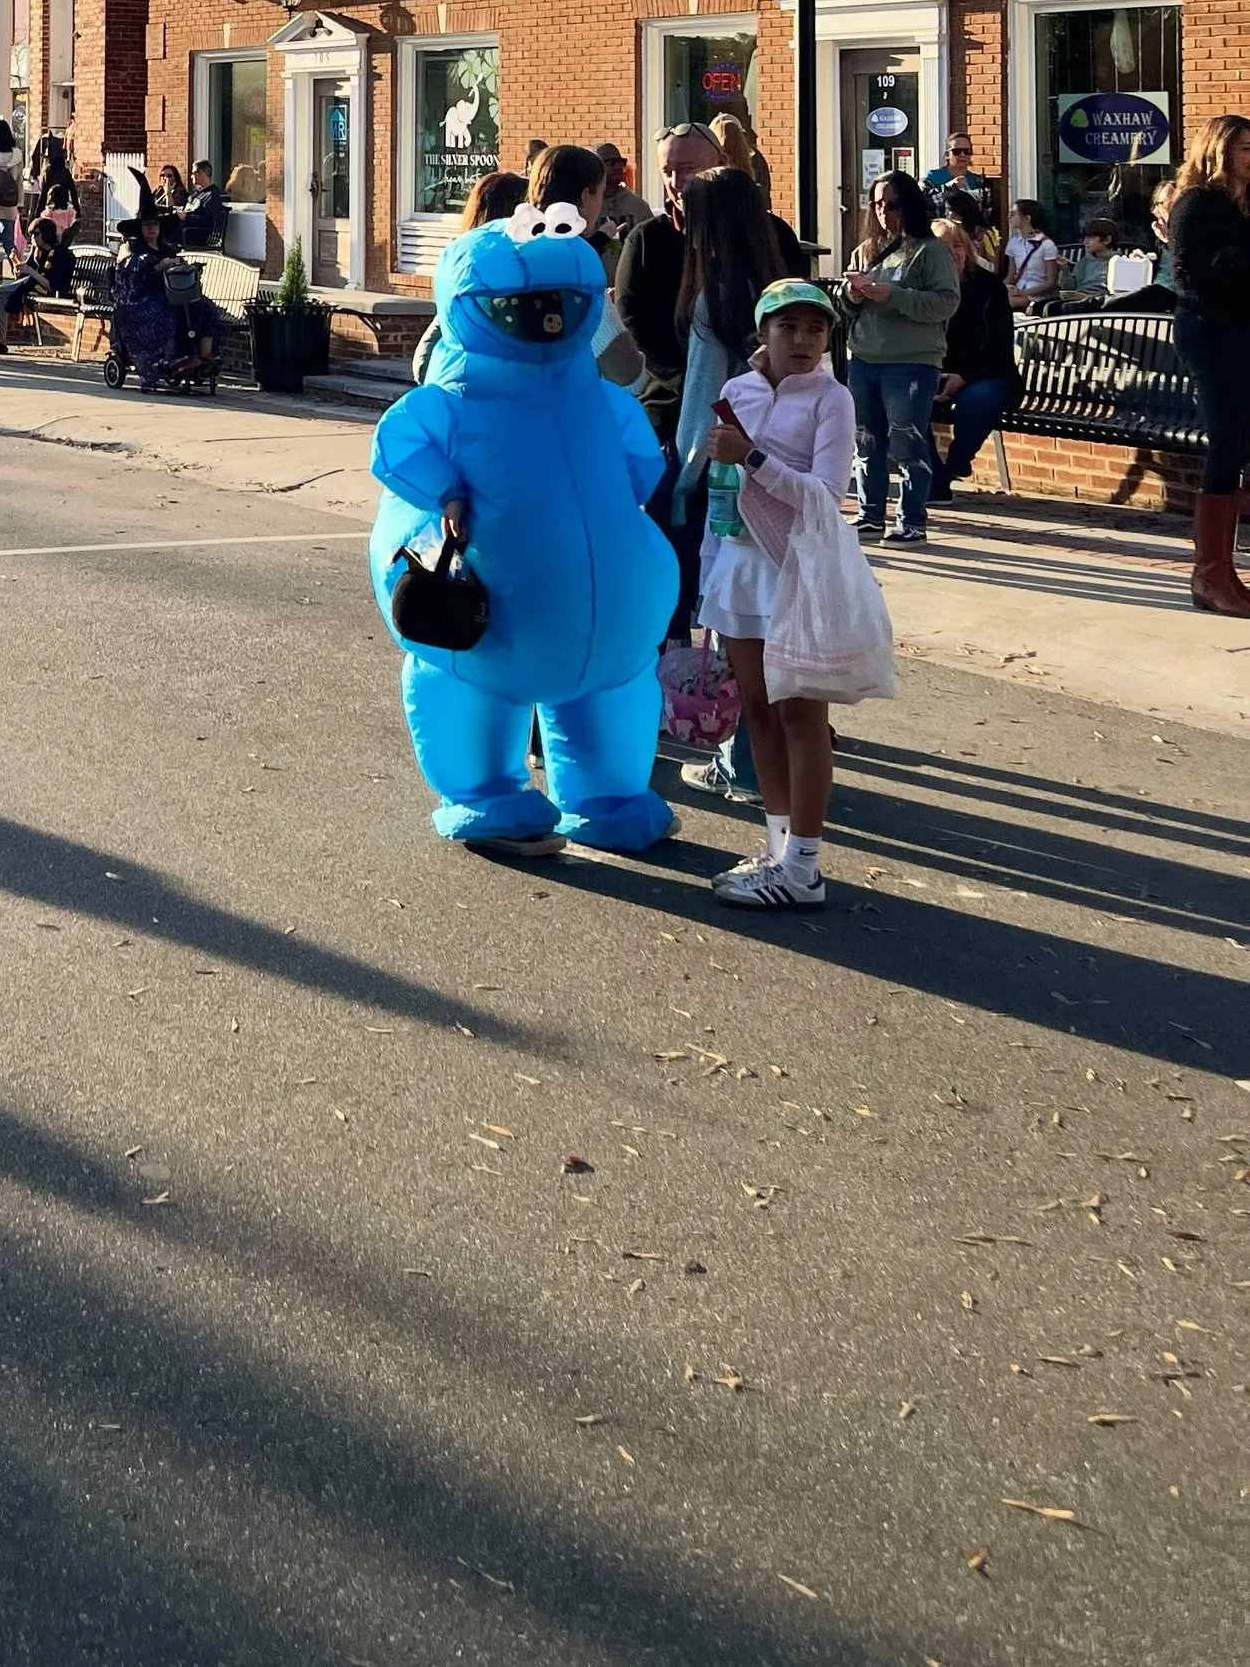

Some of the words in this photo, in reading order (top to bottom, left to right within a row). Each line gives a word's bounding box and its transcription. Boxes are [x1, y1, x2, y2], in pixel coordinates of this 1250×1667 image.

[702, 72, 741, 90] OPEN
[877, 75, 895, 88] 109
[1091, 110, 1153, 126] WAXHAW
[424, 154, 441, 165] THE
[440, 154, 469, 166] SILVER
